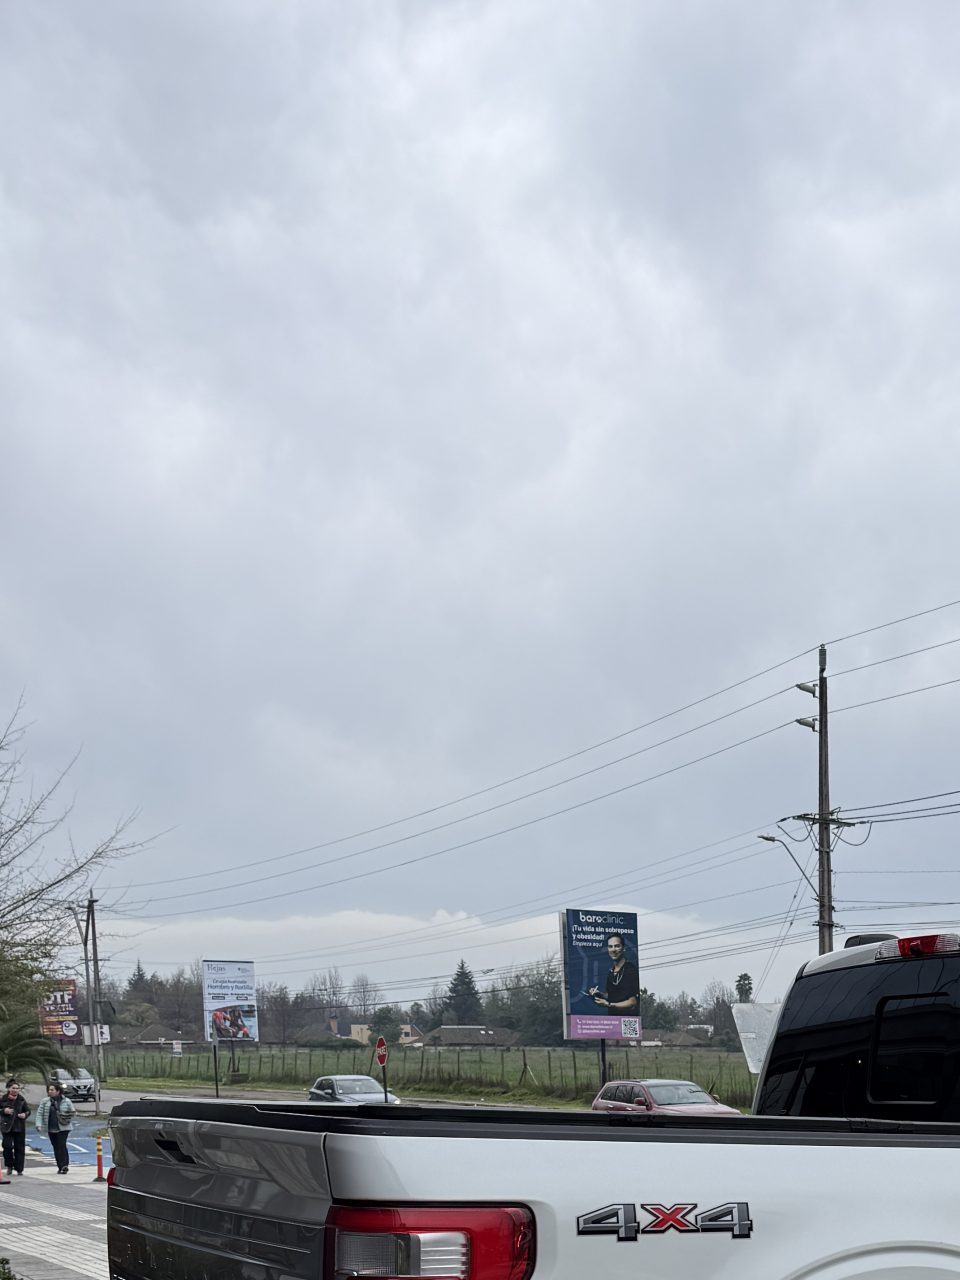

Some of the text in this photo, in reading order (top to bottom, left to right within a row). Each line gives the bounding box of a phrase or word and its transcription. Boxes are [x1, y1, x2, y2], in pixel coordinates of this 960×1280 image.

[579, 911, 624, 924] baroclinic
[605, 926, 634, 934] sobrepeso
[577, 1202, 754, 1242] 4X4
